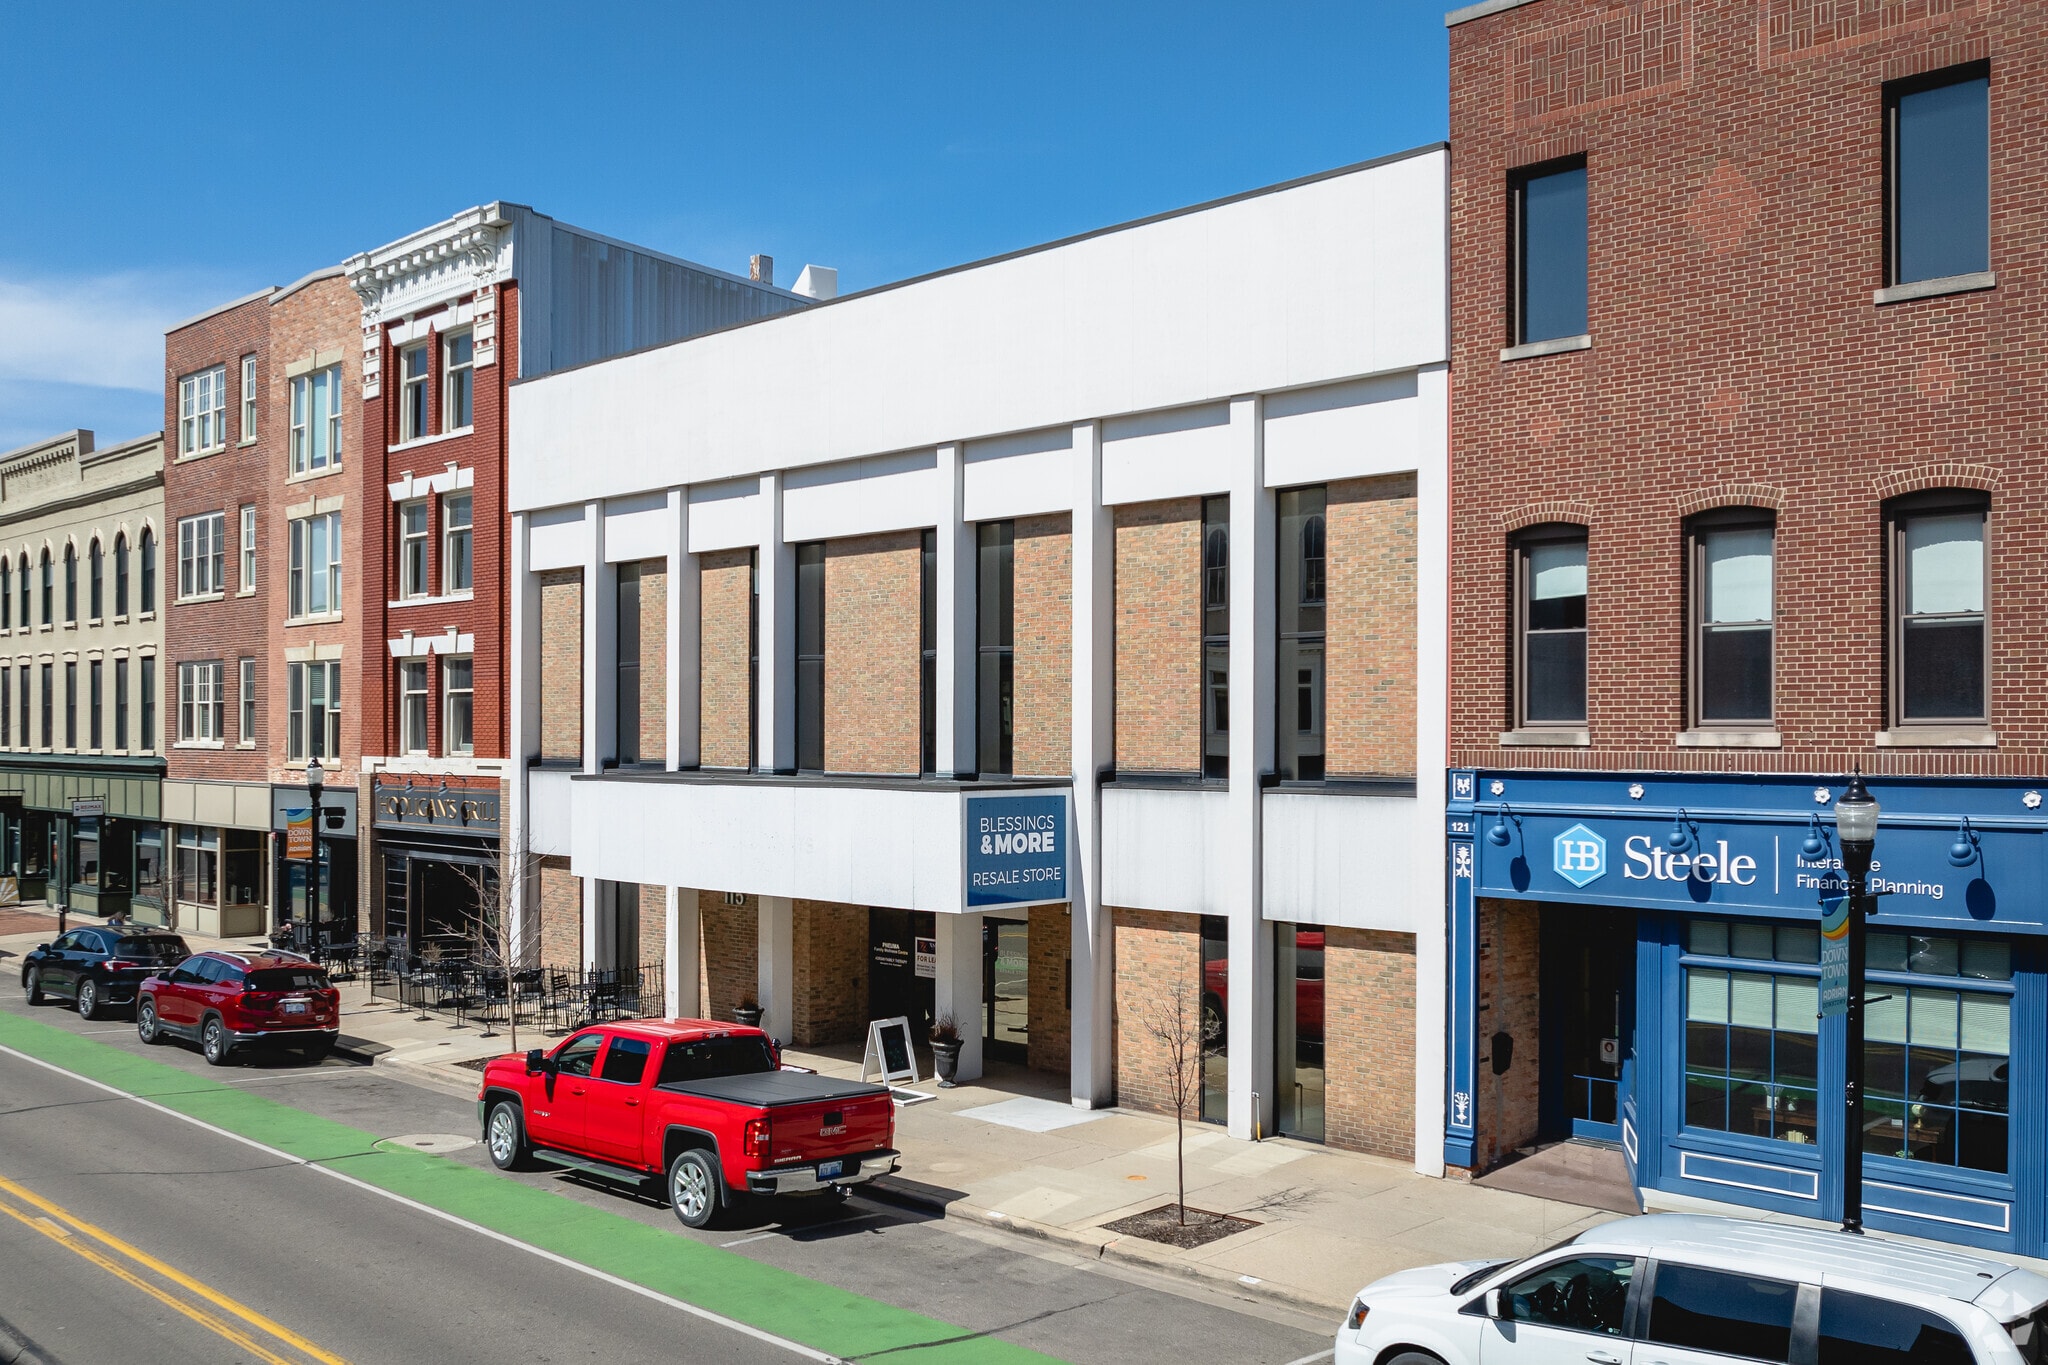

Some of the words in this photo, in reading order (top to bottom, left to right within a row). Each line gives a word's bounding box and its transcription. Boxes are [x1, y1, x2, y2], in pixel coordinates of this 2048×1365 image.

[379, 795, 458, 820] HOOLIGAN'S
[460, 799, 498, 822] GRILL
[980, 815, 1055, 833] BLESSINGS
[1451, 822, 1469, 832] 121
[1561, 840, 1600, 872] HB
[1623, 835, 1757, 887] Steele
[1796, 854, 1881, 872] Interae
[973, 870, 1020, 887] RESALE
[1022, 867, 1061, 883] STORE
[1796, 874, 1868, 891] Financ
[1871, 878, 1944, 900] Planning
[724, 891, 744, 905] 115
[1822, 947, 1848, 964] DOWN
[1822, 962, 1848, 980] TOWN
[1823, 986, 1848, 1001] ADRIAN
[819, 1125, 847, 1137] GMC
[774, 1155, 802, 1163] SIERRA
